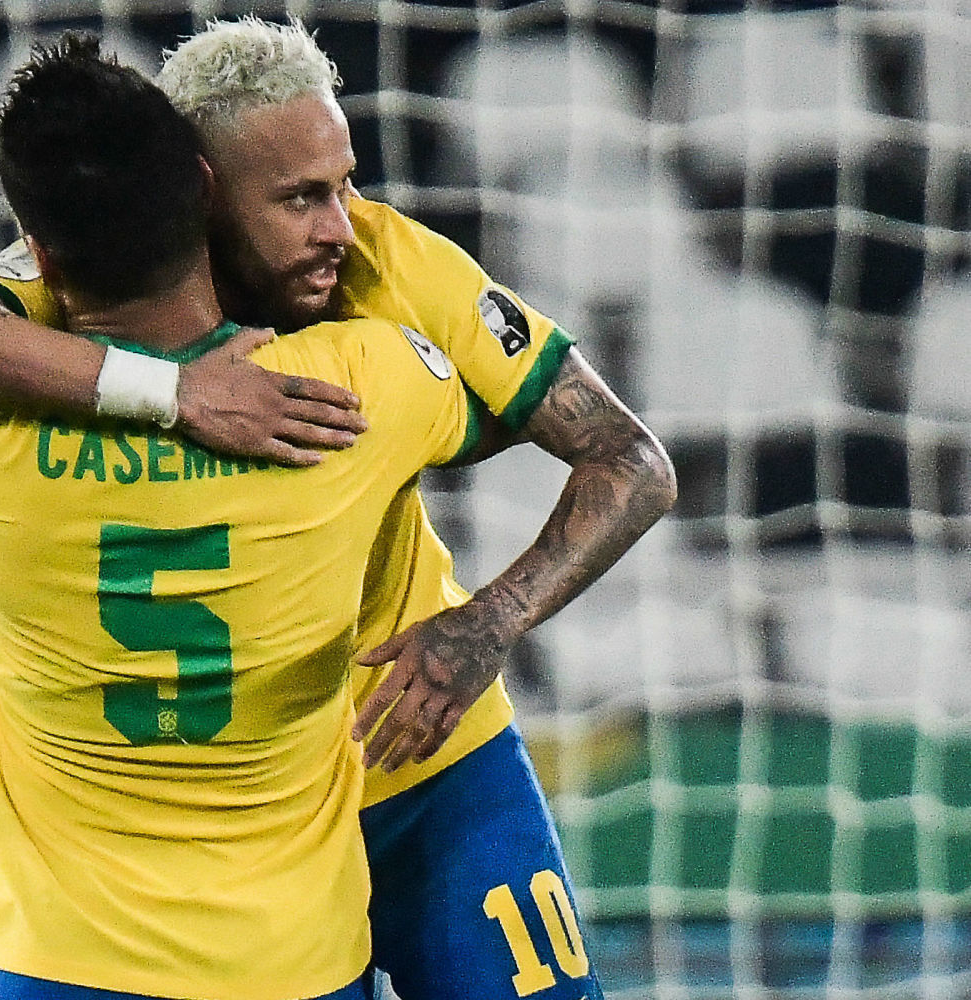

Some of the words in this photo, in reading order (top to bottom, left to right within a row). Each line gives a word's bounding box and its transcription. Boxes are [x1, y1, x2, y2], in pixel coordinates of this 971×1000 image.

[37, 423, 271, 484] CASEM
[97, 522, 233, 745] 5
[482, 868, 589, 998] 10
